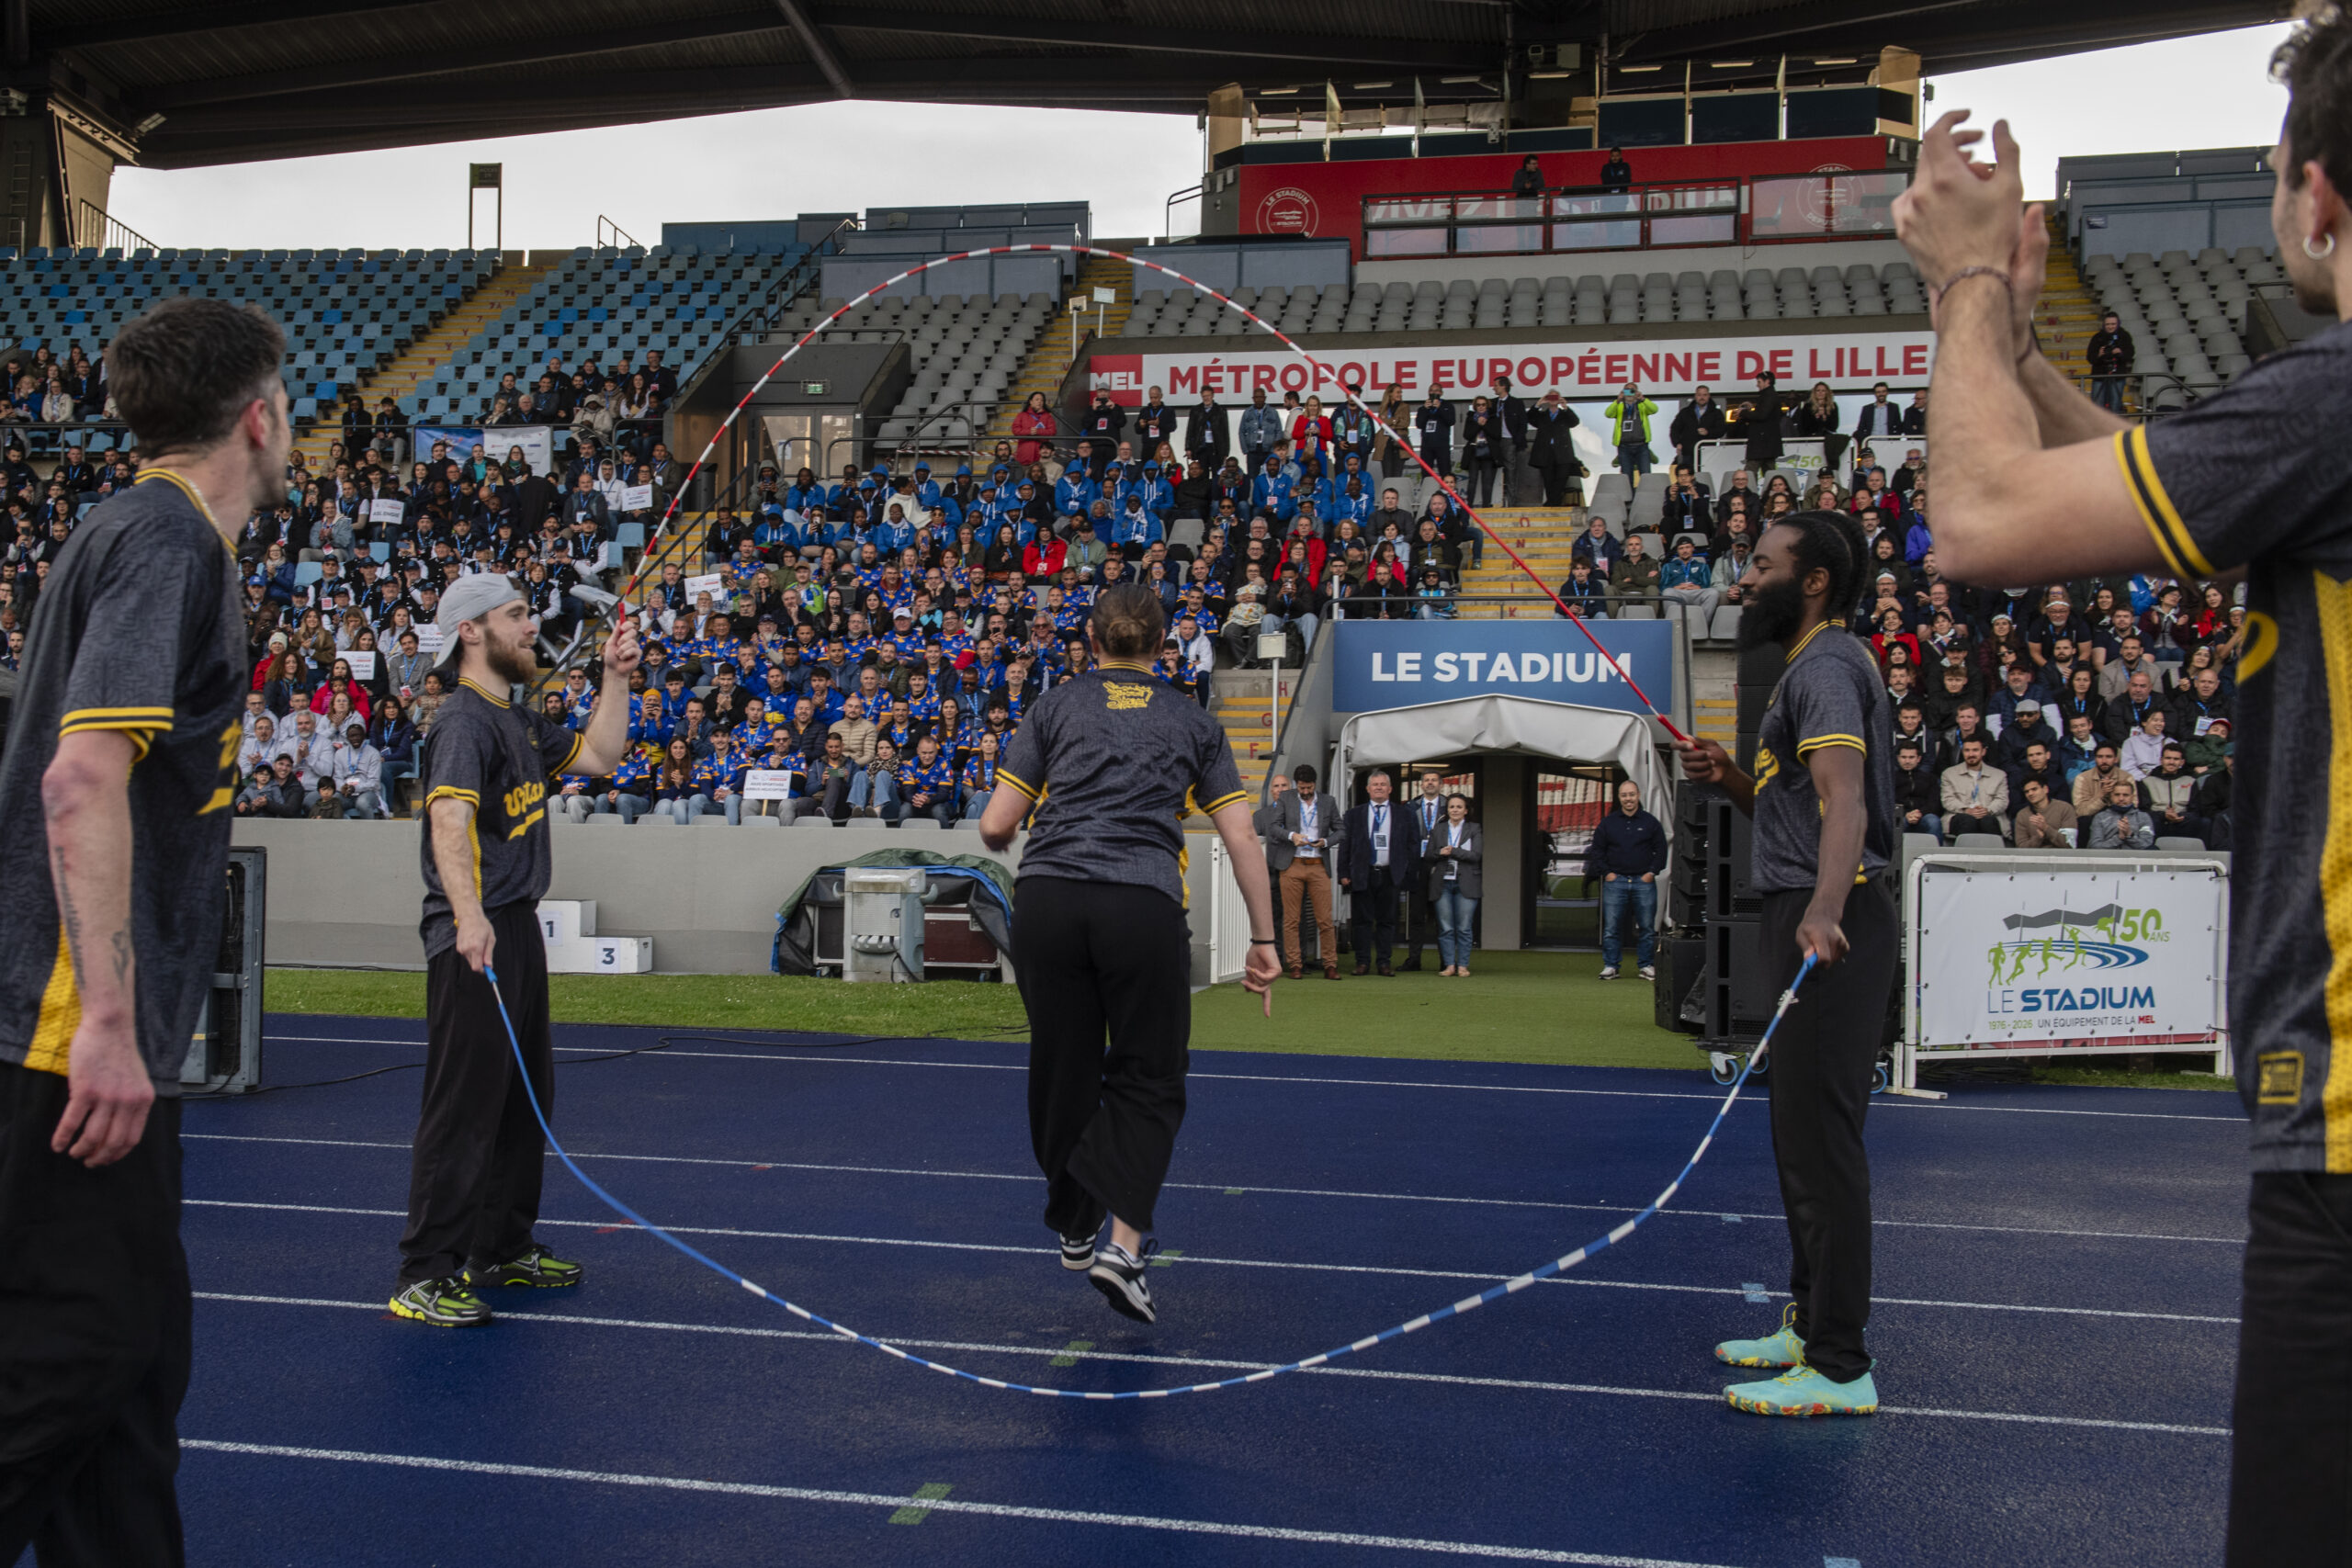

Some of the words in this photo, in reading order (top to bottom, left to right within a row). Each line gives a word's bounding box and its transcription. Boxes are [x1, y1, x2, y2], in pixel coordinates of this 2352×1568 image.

[1265, 196, 1276, 206] LE
[1275, 189, 1311, 206] STADIUM
[1090, 371, 1143, 391] MEL
[1170, 357, 1418, 395] MÉTROPOLE
[1431, 347, 1721, 389] EUROPÉENNE
[1736, 349, 1793, 380] DE
[1809, 344, 1928, 378] LILLE
[1372, 652, 1422, 682] LE
[1432, 652, 1632, 682] STADIUM
[1278, 681, 1288, 696] H
[1261, 712, 1272, 728] G
[1250, 742, 1260, 759] F
[546, 920, 554, 937] 1
[2120, 908, 2162, 942] 50
[2149, 931, 2171, 942] ANS
[602, 948, 615, 964] 3
[1988, 989, 2015, 1014] LE
[2021, 986, 2155, 1012] STADIUM
[1988, 1021, 2007, 1030] 1976
[2012, 1020, 2033, 1030] 2026
[2038, 1019, 2052, 1028] UN
[2053, 1016, 2110, 1028] ÉQUIPEMENT
[2111, 1016, 2123, 1025] DE
[2125, 1015, 2136, 1025] LA
[2138, 1014, 2156, 1024] MEL
